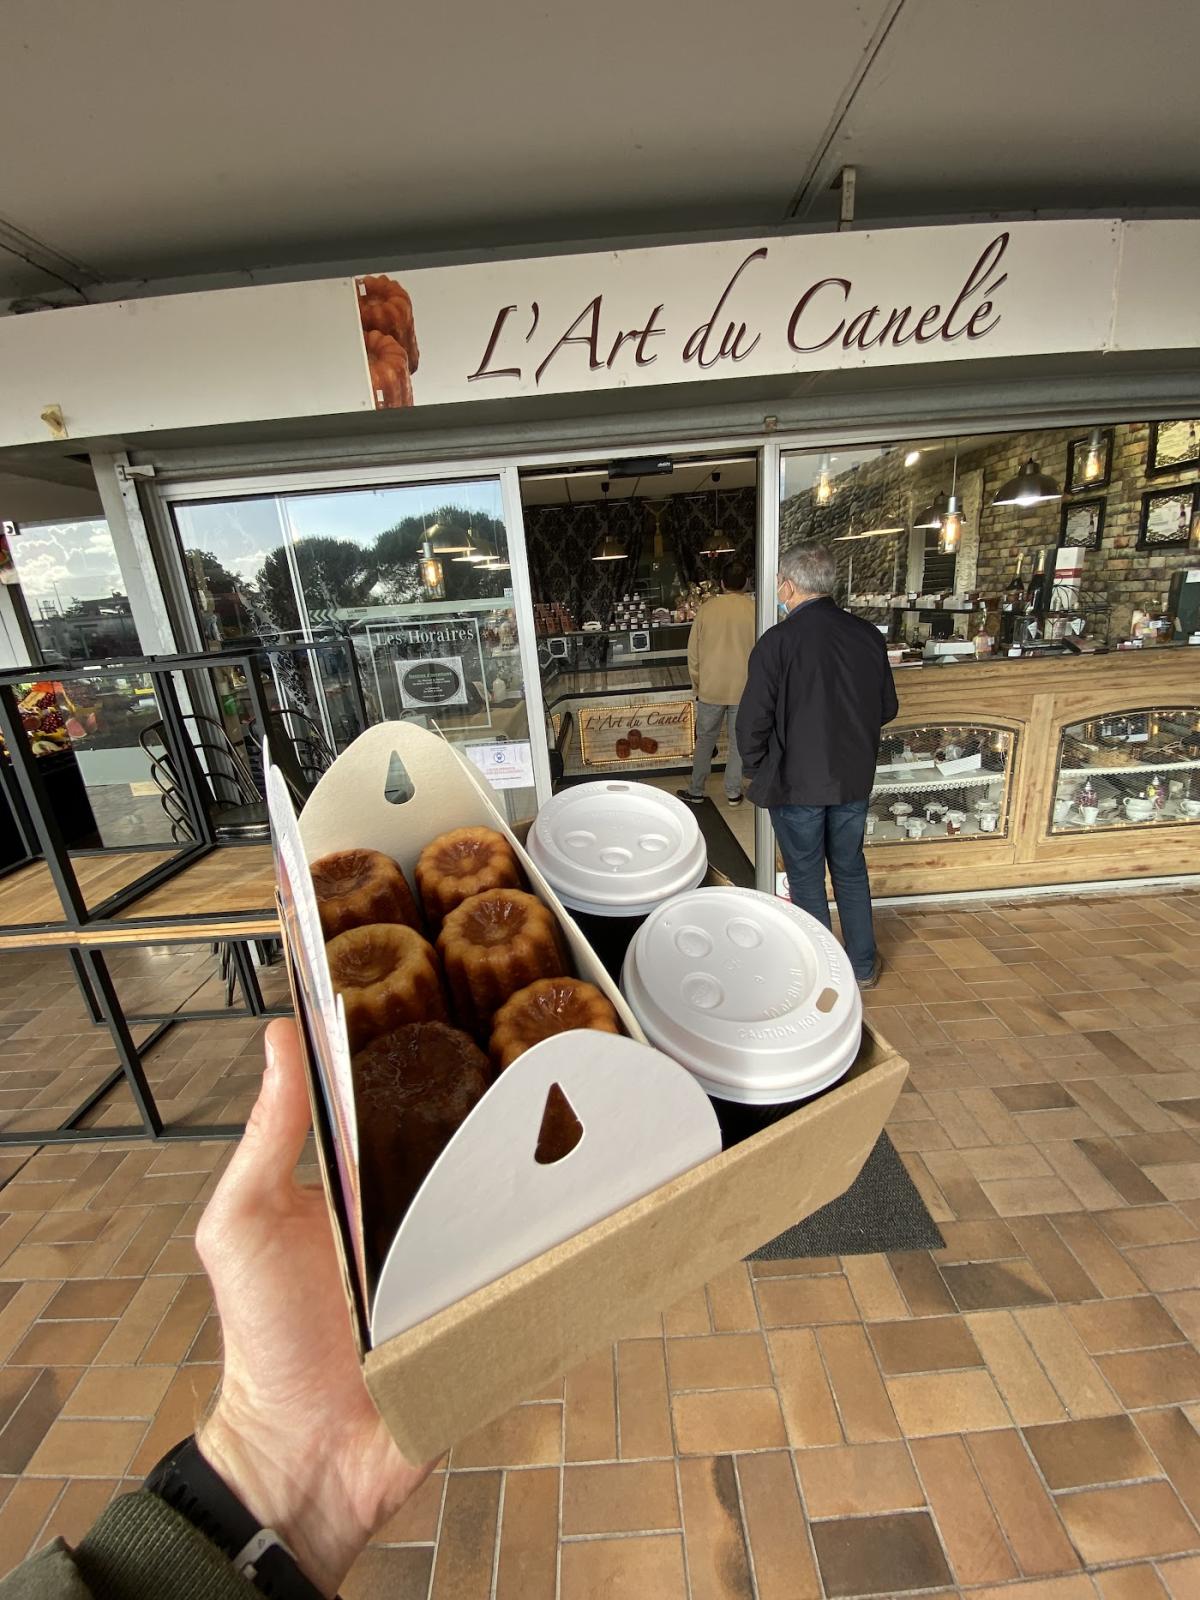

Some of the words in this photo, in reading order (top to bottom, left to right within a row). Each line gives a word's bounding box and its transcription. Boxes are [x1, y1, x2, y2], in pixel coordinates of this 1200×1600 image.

[467, 294, 666, 387] L'Art
[682, 247, 768, 368] du
[787, 231, 1010, 354] Canelé
[376, 633, 403, 646] Les
[408, 628, 474, 644] Horaires
[584, 714, 622, 731] L'Art
[626, 707, 643, 729] du
[737, 1024, 797, 1041] CAUTION
[797, 1011, 822, 1031] HOT
